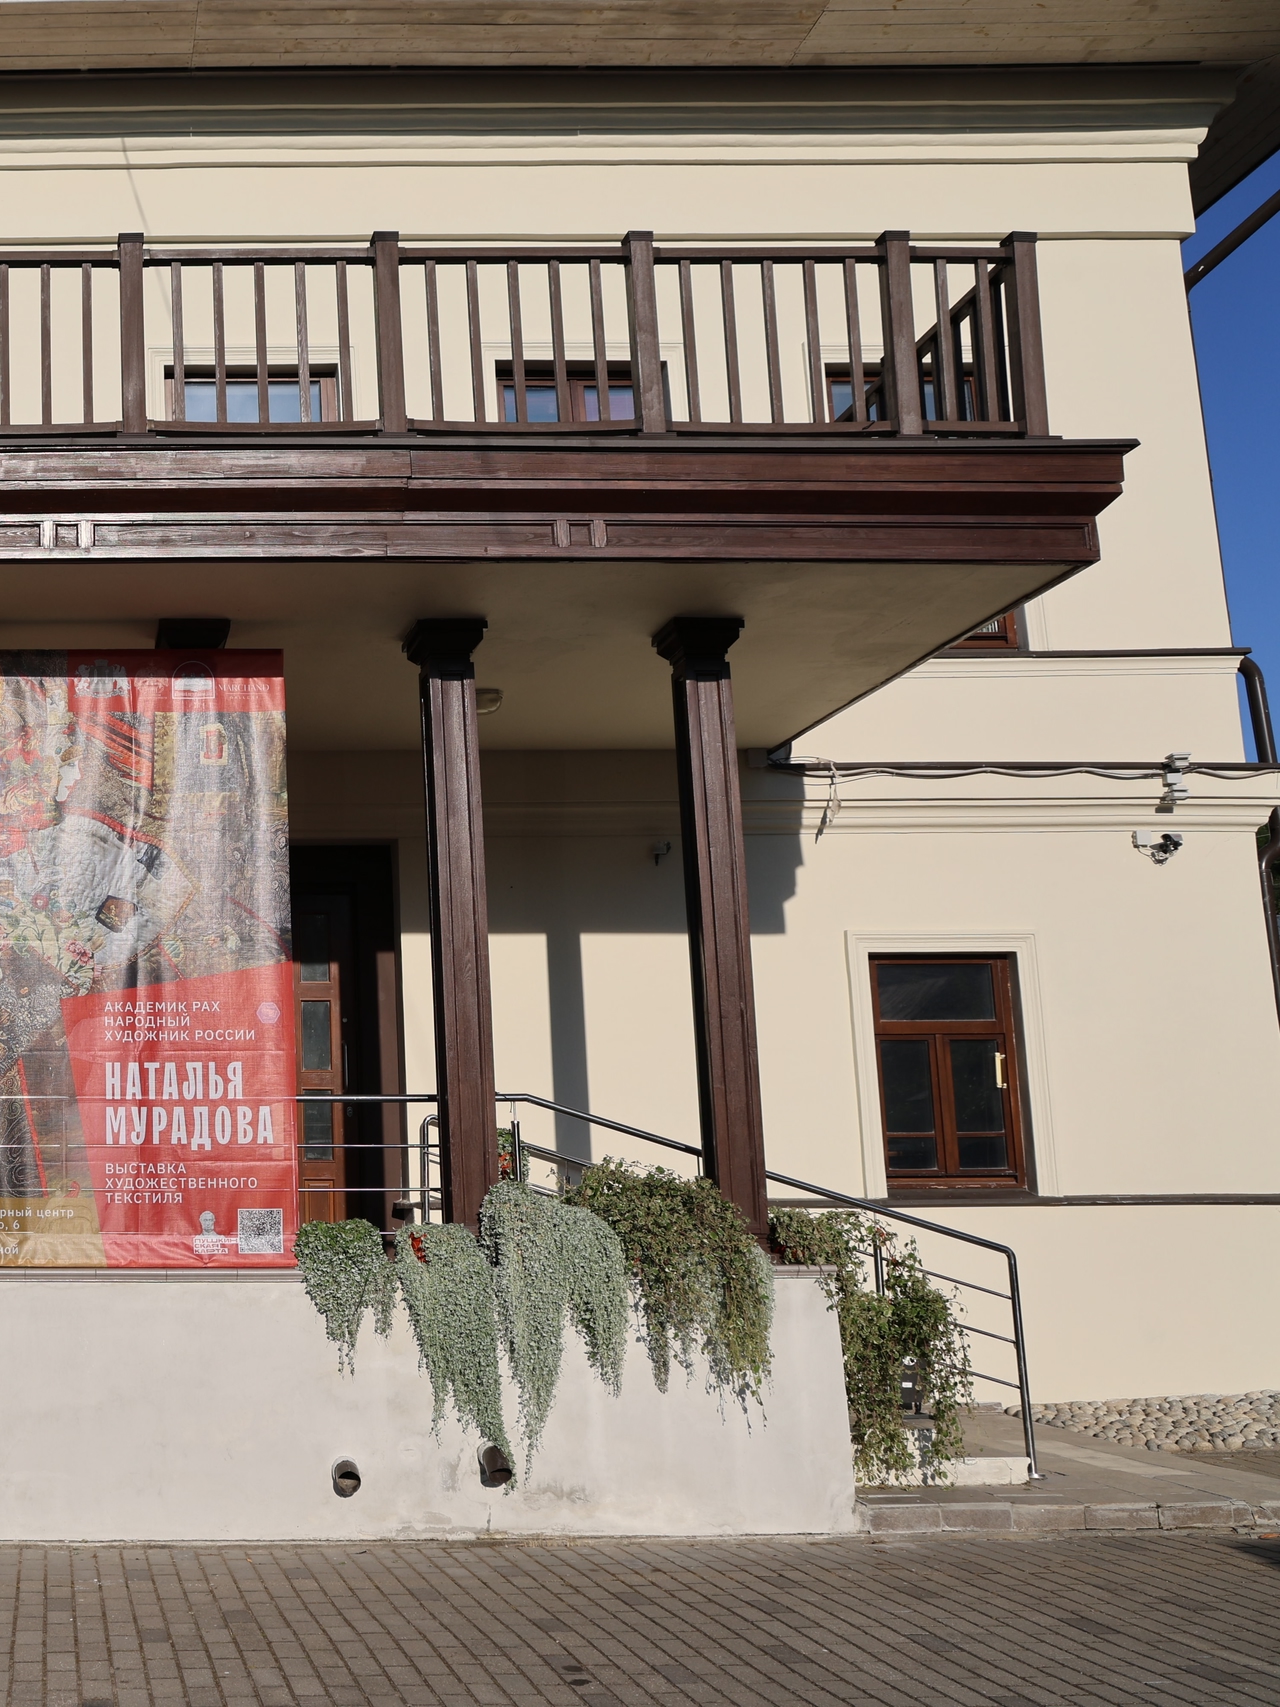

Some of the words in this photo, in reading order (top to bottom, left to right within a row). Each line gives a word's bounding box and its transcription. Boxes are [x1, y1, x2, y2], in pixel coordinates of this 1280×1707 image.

[104, 1001, 187, 1014] АКАДЕМИК
[192, 1001, 221, 1012] РАХ
[104, 1013, 191, 1028] НАРОДНЫЙ
[104, 1030, 190, 1043] ХУДОЖНИК
[195, 1029, 256, 1041] РОССИИ
[105, 1061, 243, 1100] НАТАЛЬЯ
[105, 1105, 274, 1151] МУРАДОВА
[105, 1163, 187, 1175] ВЫСТАВКА
[105, 1177, 258, 1191] ХУДОЖЕСТВЕННОГО
[105, 1192, 183, 1204] ТЕКСТИЛЯ
[36, 1208, 74, 1219] центр
[12, 1219, 21, 1230] 6
